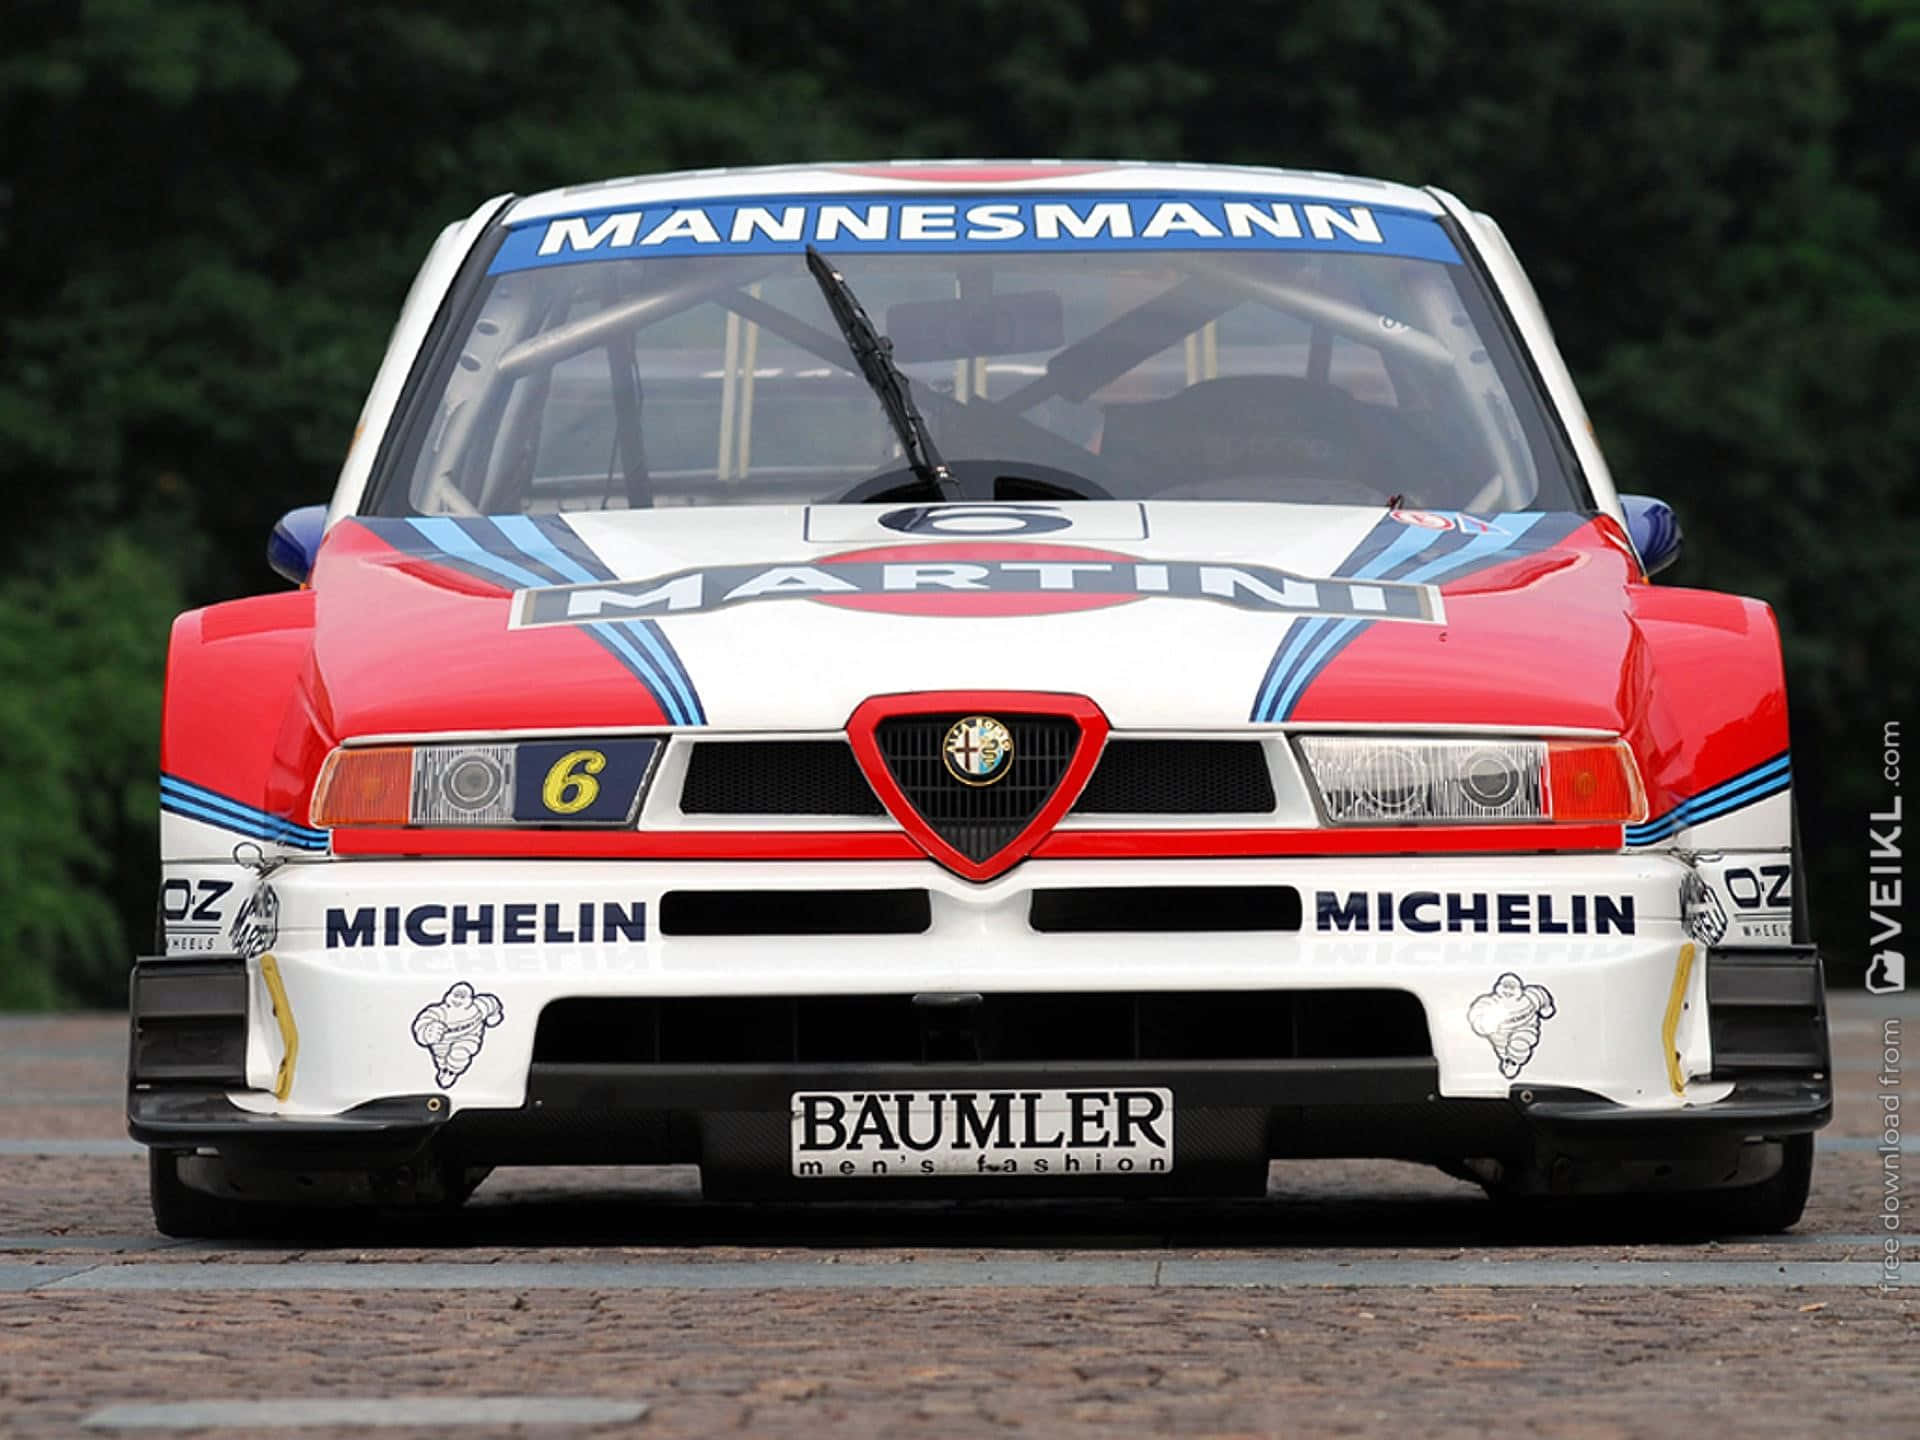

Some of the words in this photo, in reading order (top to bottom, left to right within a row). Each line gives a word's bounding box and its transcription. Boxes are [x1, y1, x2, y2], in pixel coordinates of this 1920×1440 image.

[537, 203, 1384, 256] MANNESMANN
[567, 564, 1387, 617] MARTINI
[542, 750, 606, 814] 6
[326, 902, 647, 948] MICHELIN
[1316, 891, 1636, 936] MICHELIN
[800, 1091, 1166, 1151] BÄUMLER
[800, 1154, 935, 1175] men's
[977, 1153, 1166, 1174] fashion
